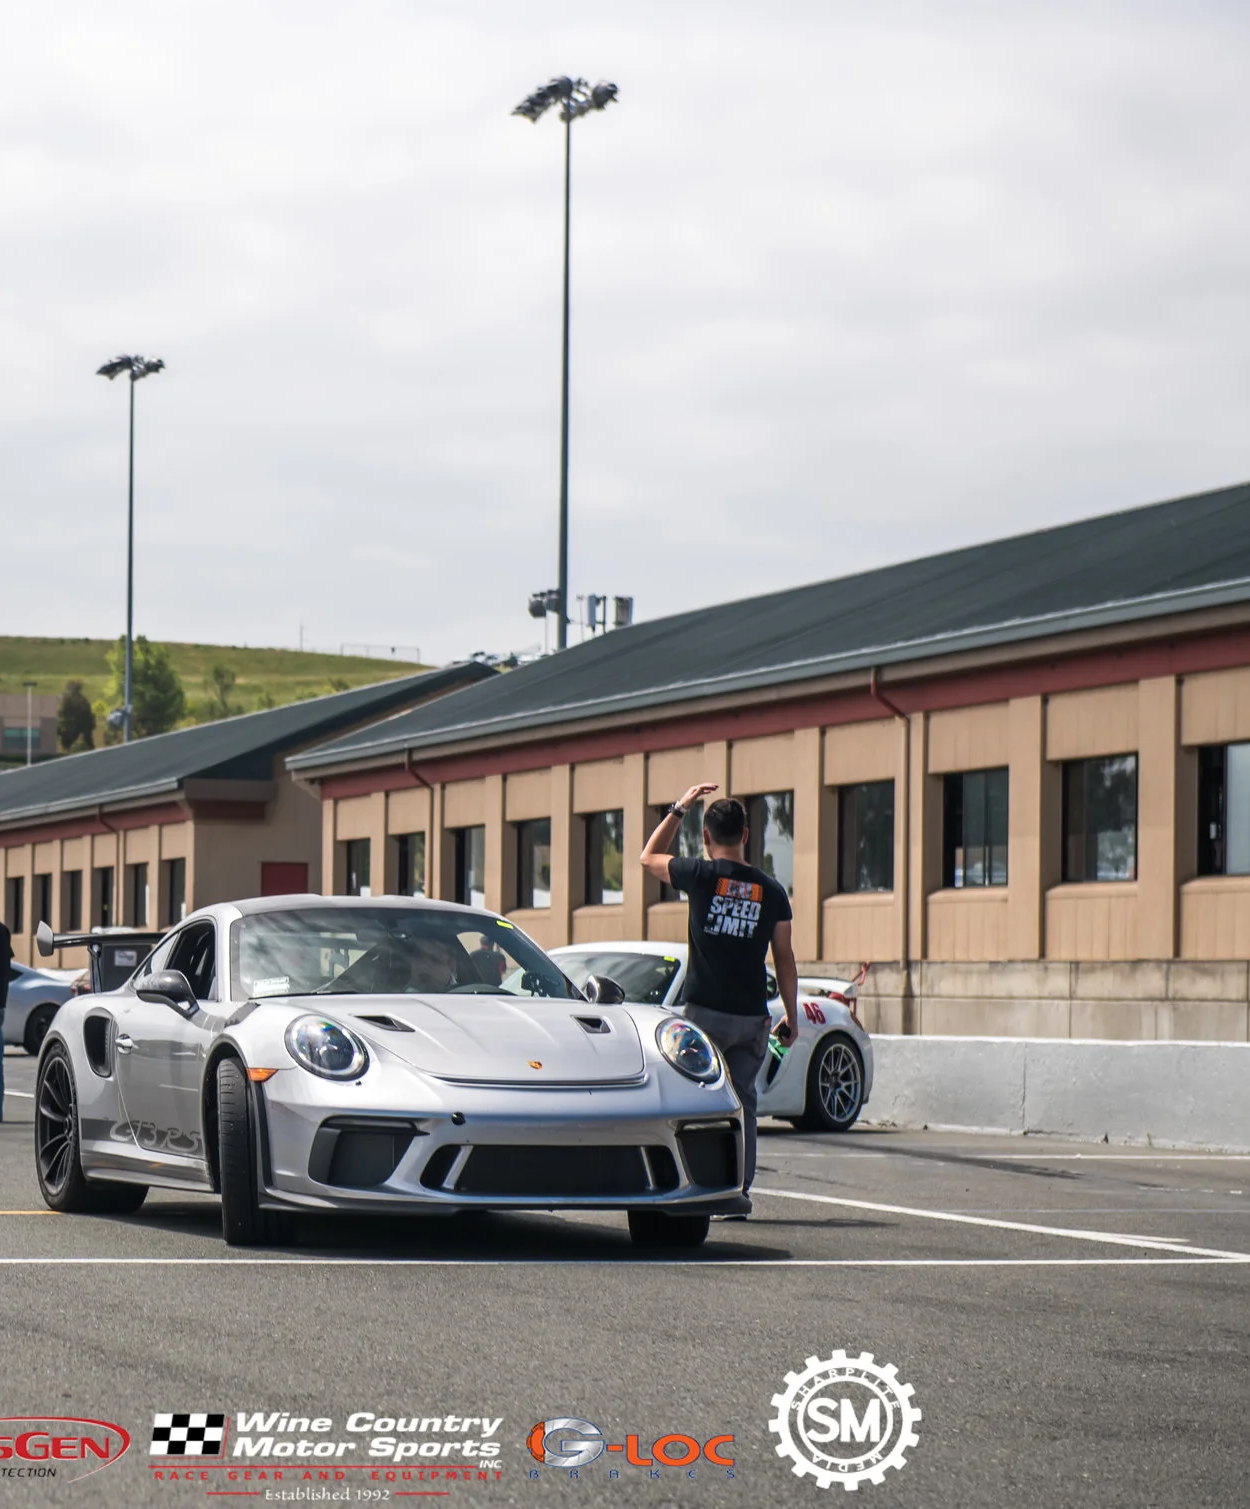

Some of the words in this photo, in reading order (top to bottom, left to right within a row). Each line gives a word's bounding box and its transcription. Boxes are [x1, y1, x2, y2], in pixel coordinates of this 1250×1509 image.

[710, 895, 762, 921] SPEED
[703, 913, 758, 938] LIMIT
[803, 1002, 826, 1025] 46
